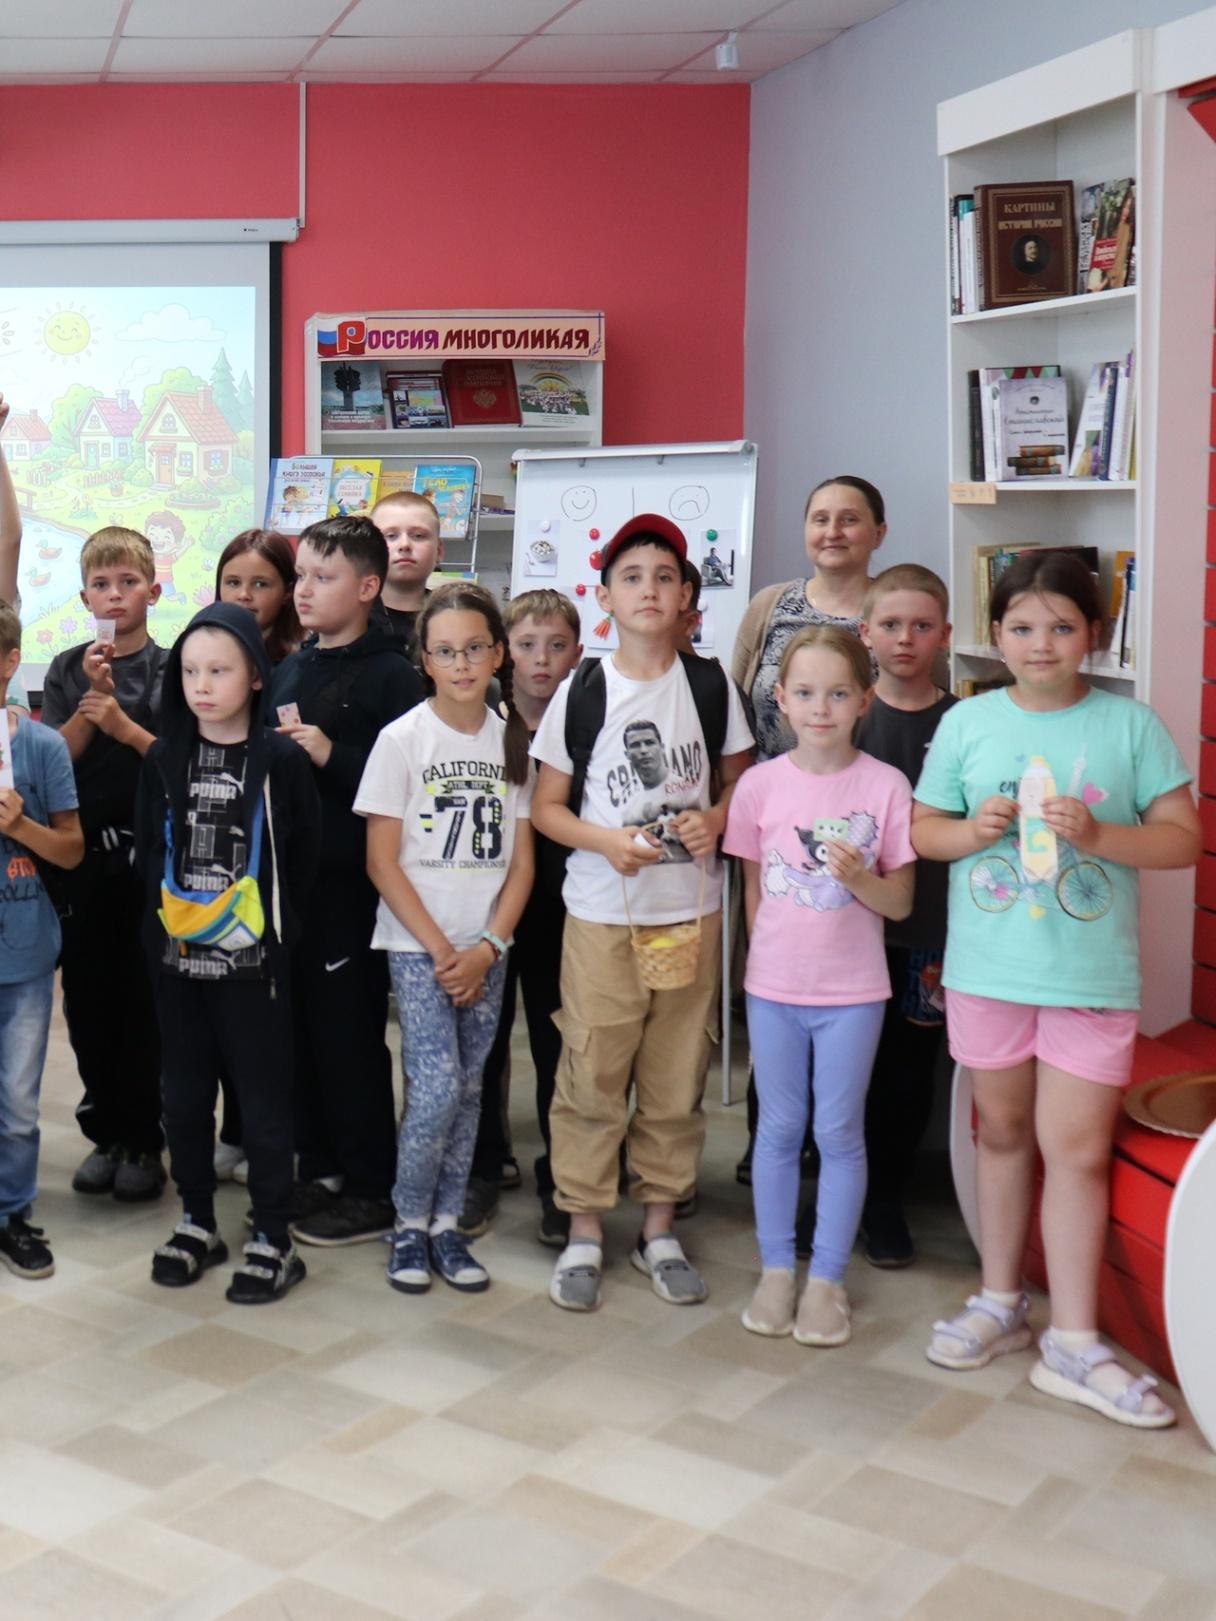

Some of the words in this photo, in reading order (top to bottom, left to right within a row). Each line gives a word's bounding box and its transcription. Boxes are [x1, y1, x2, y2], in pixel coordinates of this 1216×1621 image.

[336, 320, 439, 353] РОССИЯ
[442, 328, 590, 351] МНОГОЛИКАЯ
[422, 760, 507, 784] CALIFORNI
[189, 782, 237, 800] PUMA
[434, 796, 503, 860] 78
[178, 957, 228, 975] PUMA
